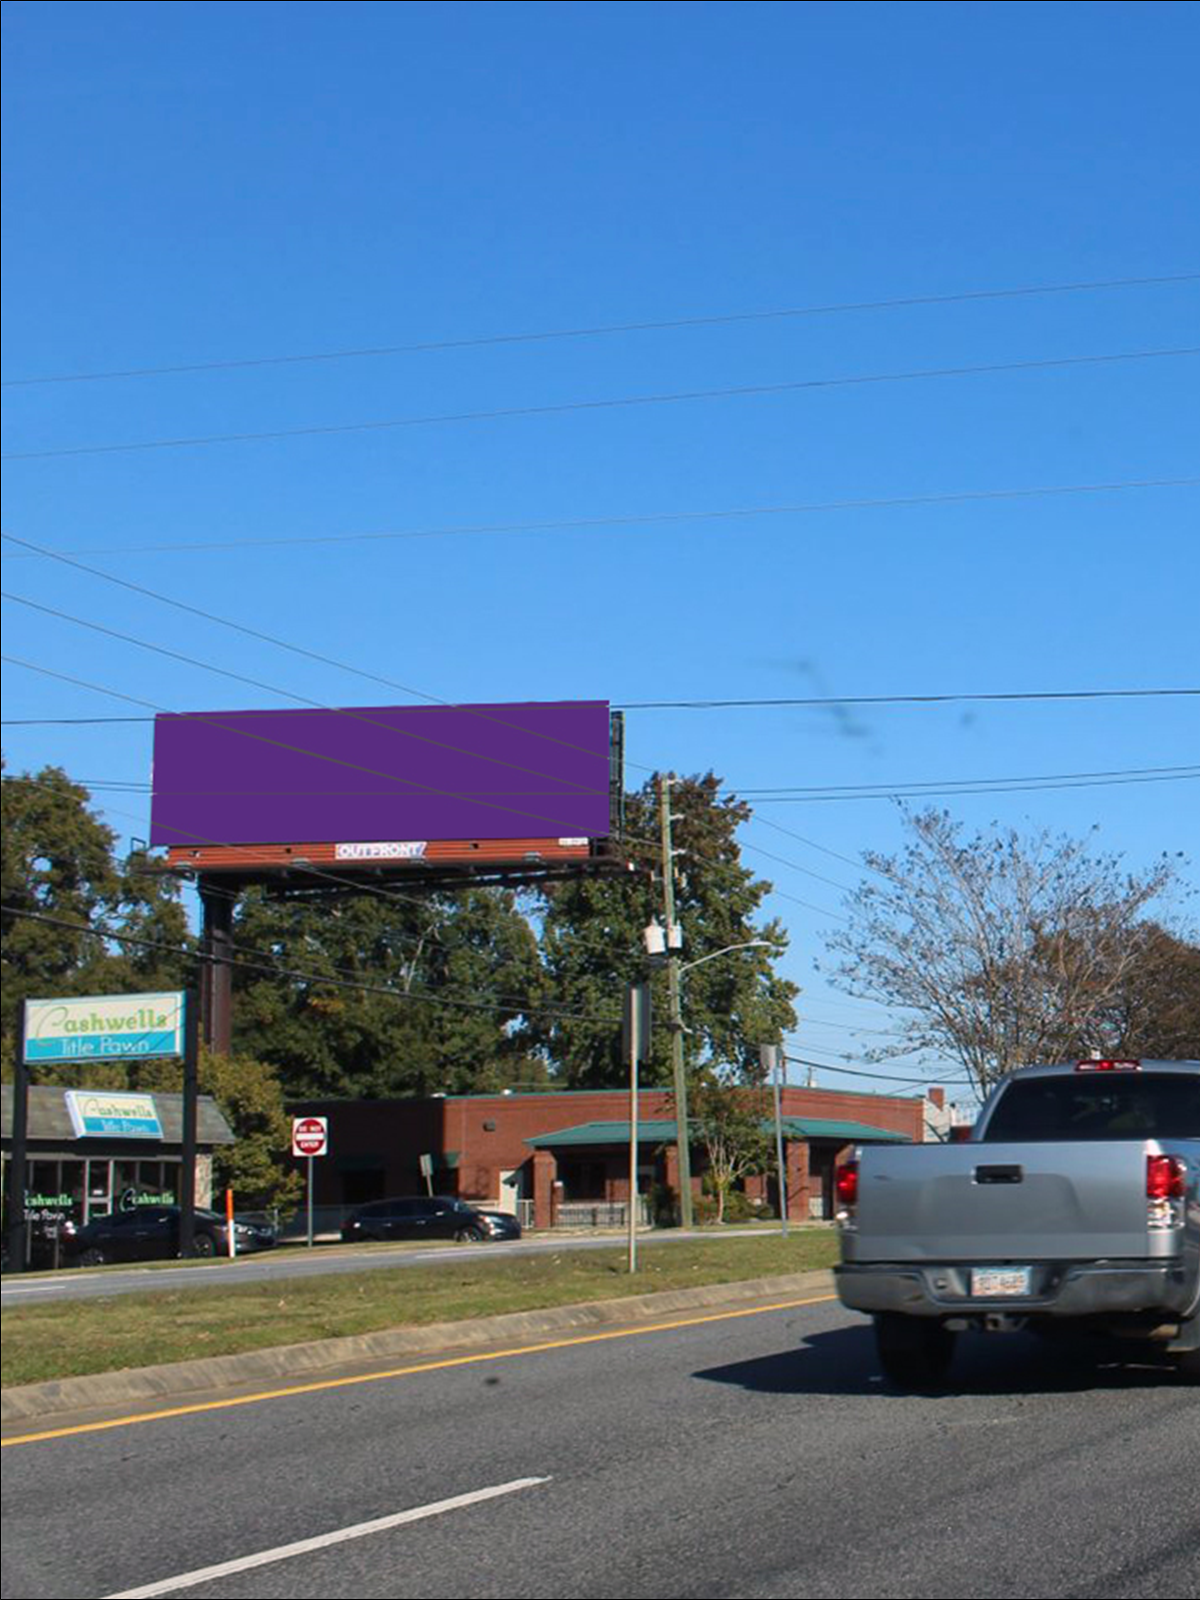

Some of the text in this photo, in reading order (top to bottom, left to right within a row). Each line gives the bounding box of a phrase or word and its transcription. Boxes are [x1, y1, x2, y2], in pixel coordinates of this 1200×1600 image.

[36, 1006, 167, 1046] Cashwells
[60, 1036, 150, 1056] Title Pawn
